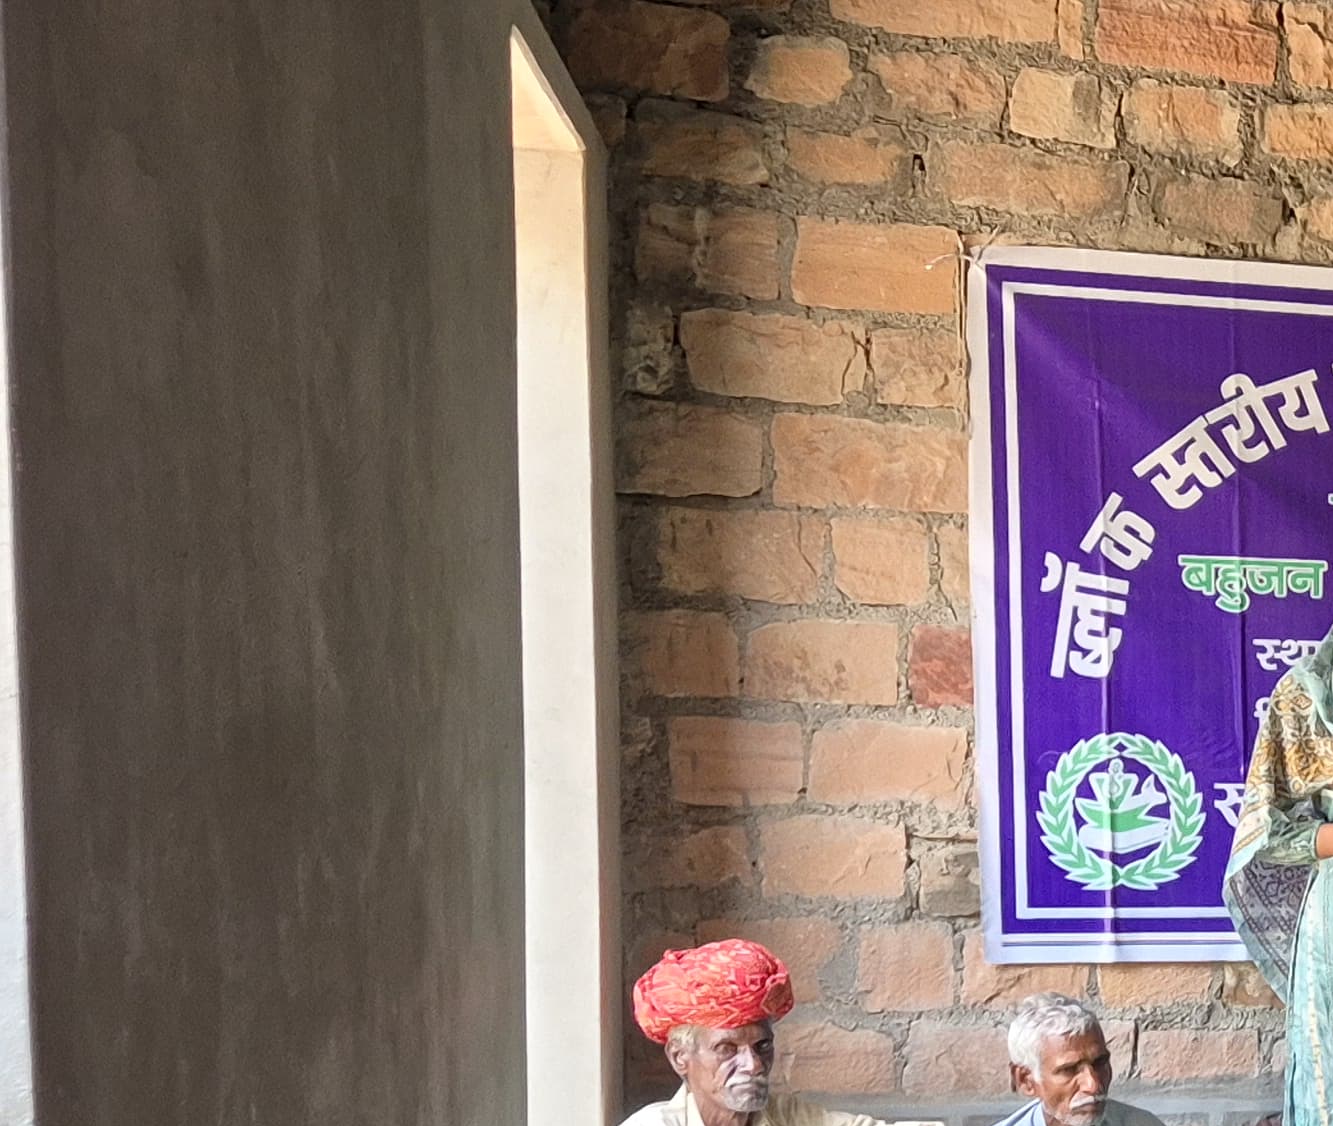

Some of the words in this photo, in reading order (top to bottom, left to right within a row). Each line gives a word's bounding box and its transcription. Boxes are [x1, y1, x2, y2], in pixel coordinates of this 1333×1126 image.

[1040, 492, 1156, 678] ब्लॉक
[1132, 368, 1331, 511] स्तरीय
[1178, 554, 1328, 613] बहुजन
